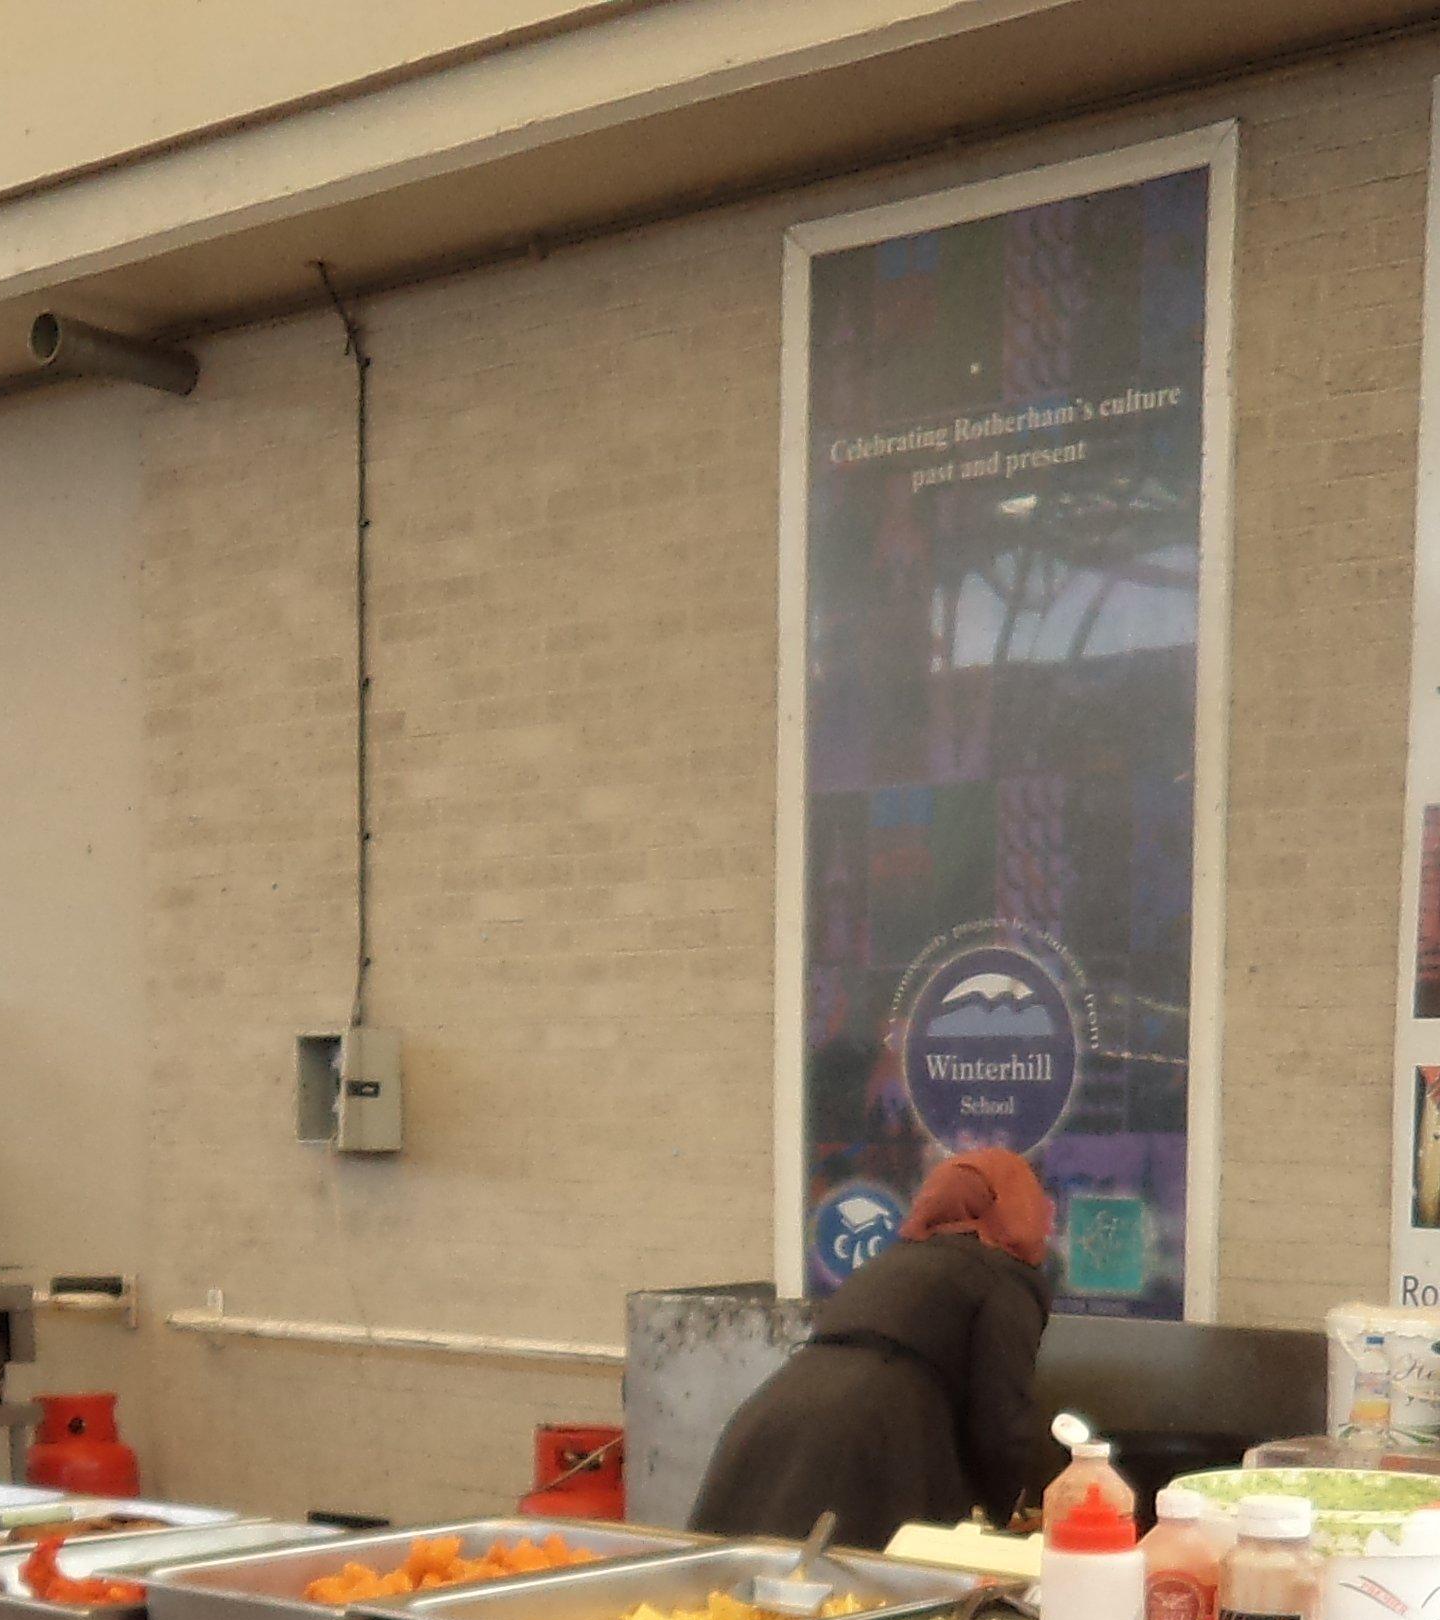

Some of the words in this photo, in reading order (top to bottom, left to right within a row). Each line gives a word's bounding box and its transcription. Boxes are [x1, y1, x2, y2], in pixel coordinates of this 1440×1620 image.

[830, 425, 948, 465] Celebrating
[954, 397, 1093, 442] Rotherham's
[1100, 386, 1181, 418] culture
[912, 461, 954, 494] past
[961, 450, 999, 479] and
[1006, 440, 1089, 478] present
[926, 1053, 1053, 1082] Winterhill
[960, 1095, 1016, 1116] School
